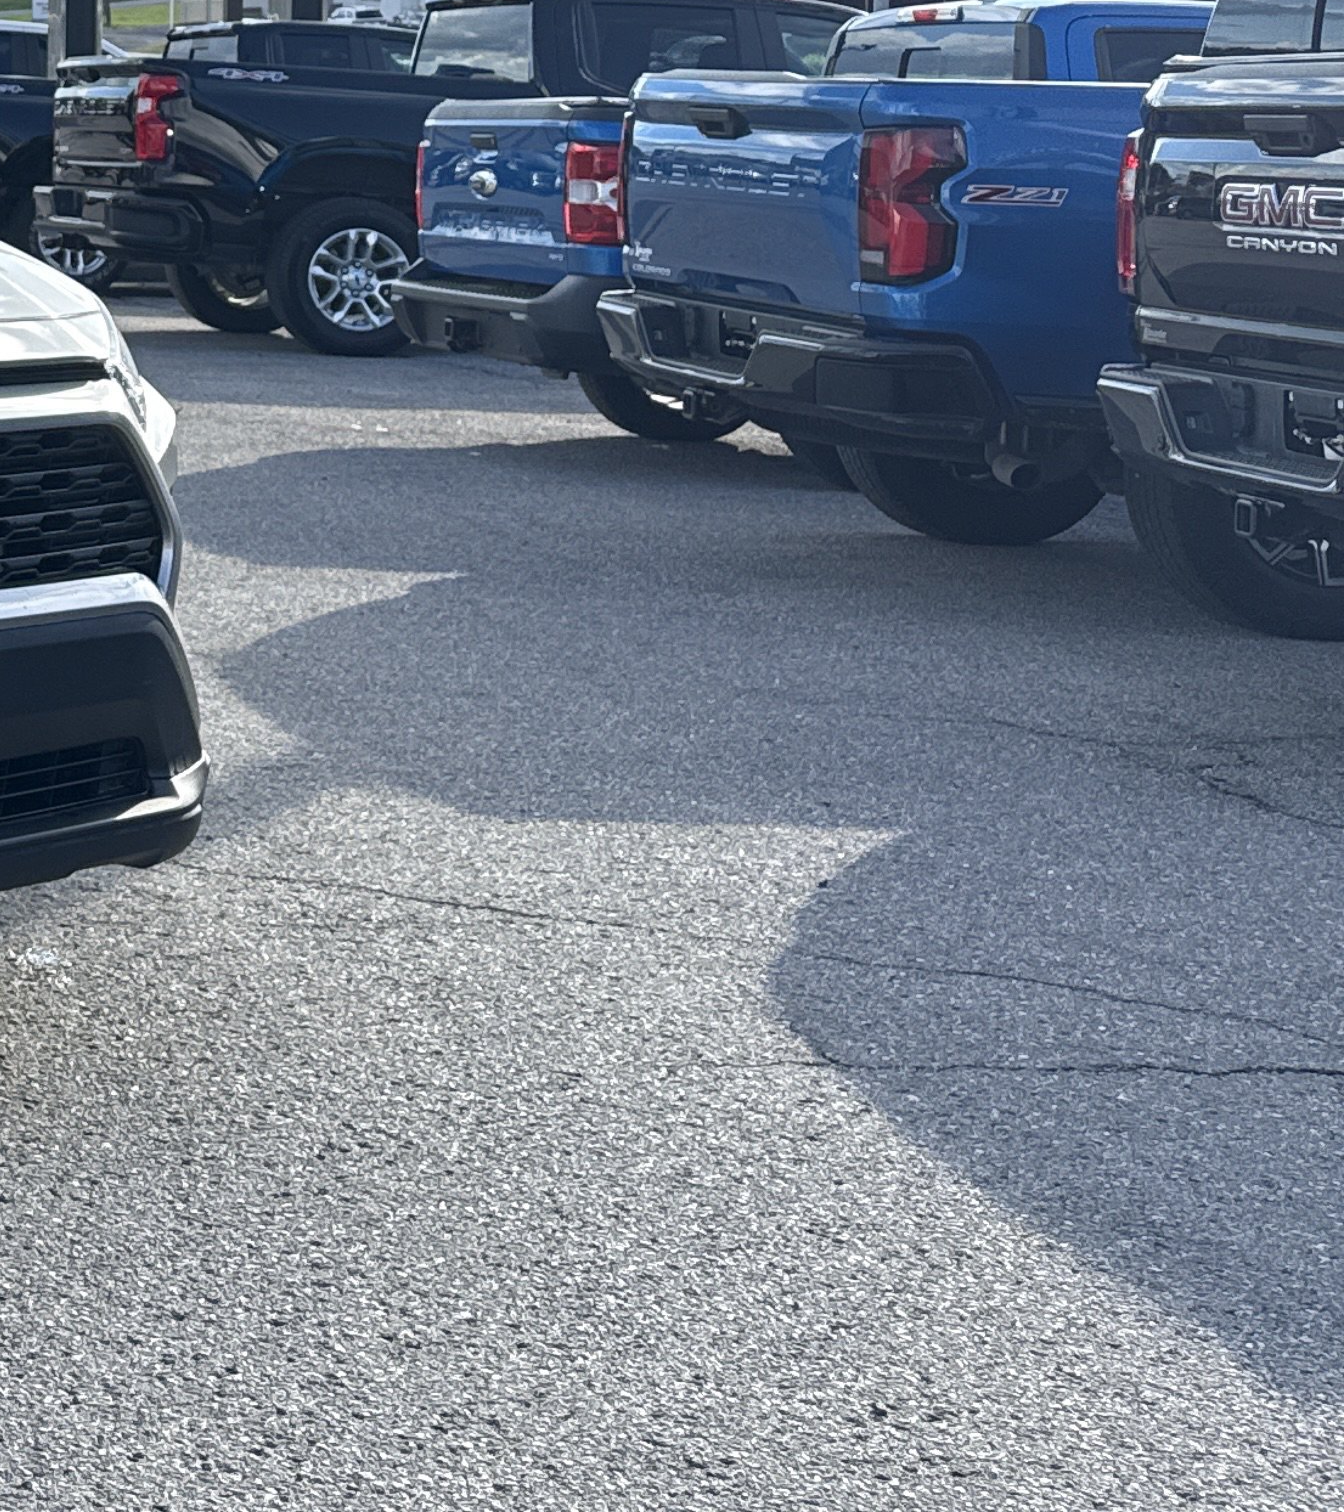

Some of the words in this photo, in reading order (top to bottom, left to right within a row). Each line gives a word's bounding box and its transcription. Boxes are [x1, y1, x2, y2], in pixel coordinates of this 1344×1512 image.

[960, 184, 1069, 207] Z71
[1220, 182, 1344, 230] GMC
[1226, 235, 1338, 256] CANYON
